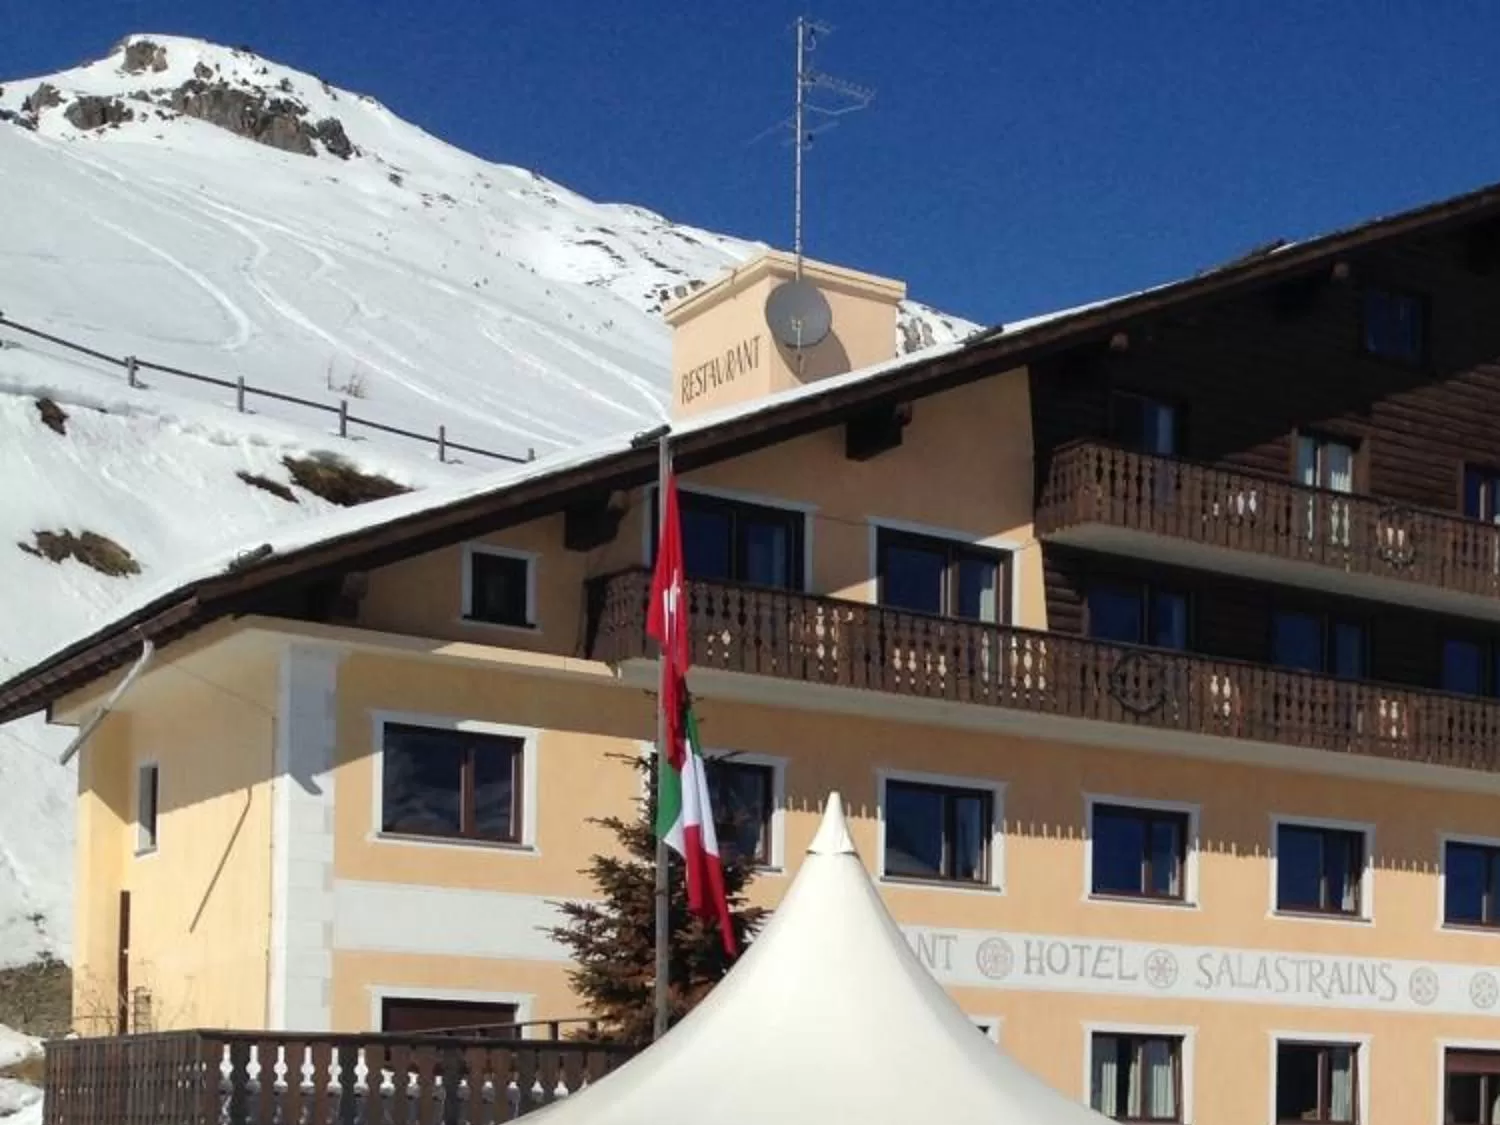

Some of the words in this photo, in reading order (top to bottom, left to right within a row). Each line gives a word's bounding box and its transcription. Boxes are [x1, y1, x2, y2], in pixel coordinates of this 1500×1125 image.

[681, 335, 761, 405] RESTAURANT
[1023, 940, 1138, 981] HOTEL
[1195, 953, 1398, 1002] SALASTRAINS
